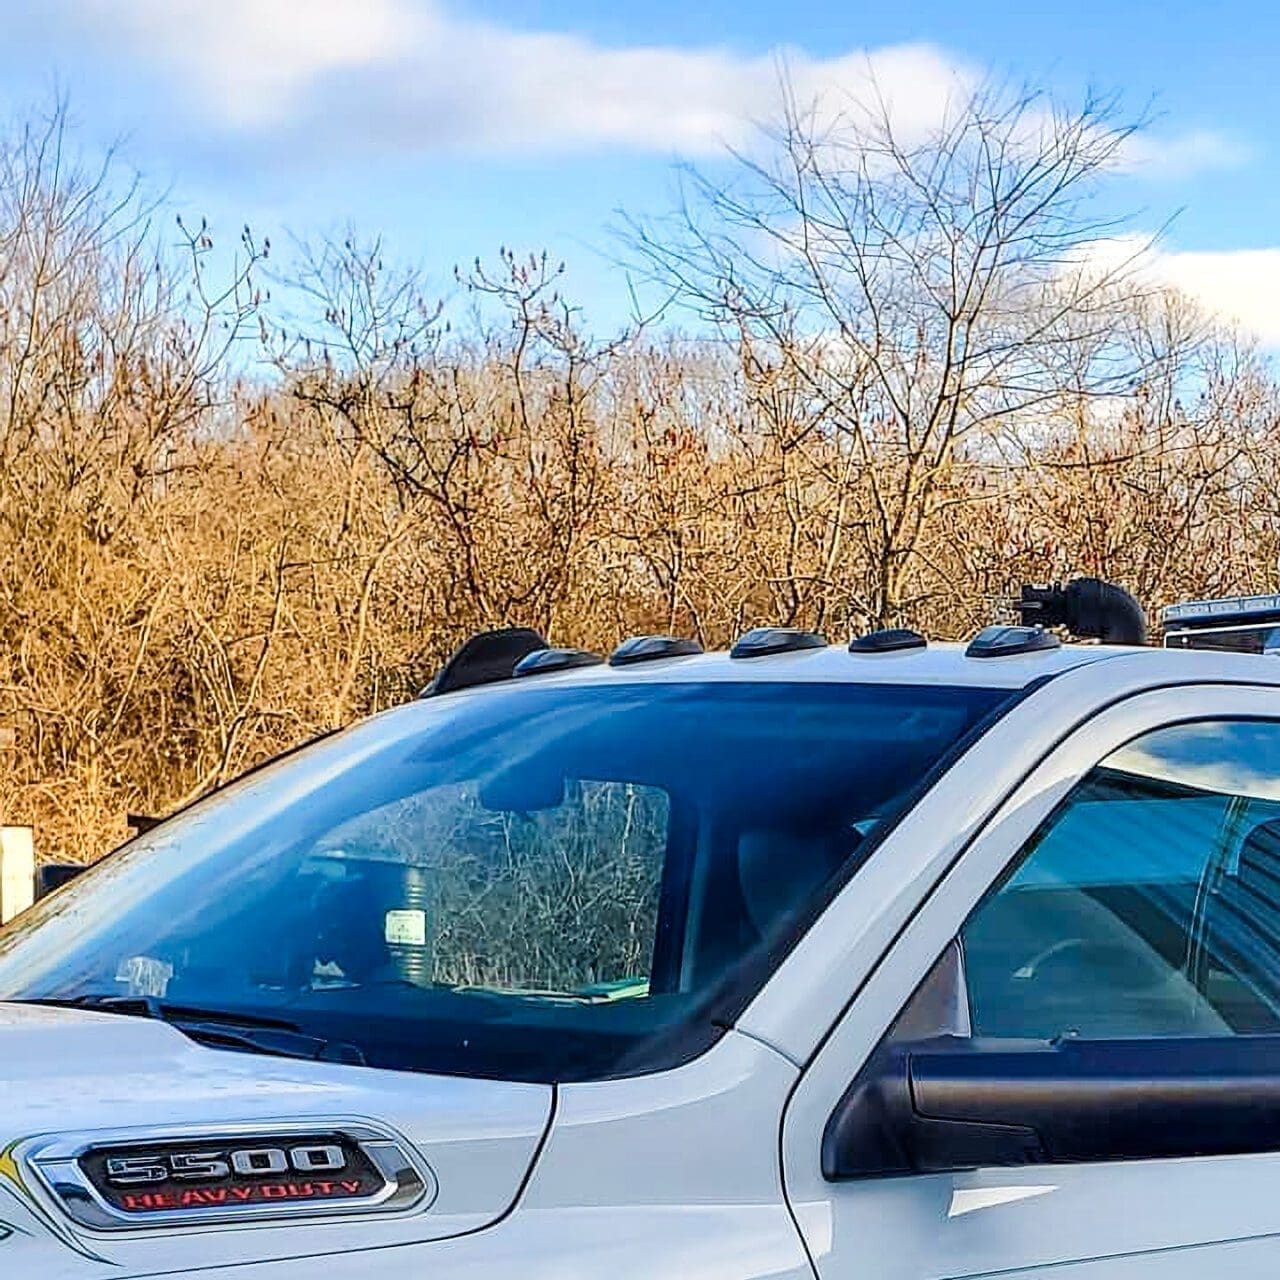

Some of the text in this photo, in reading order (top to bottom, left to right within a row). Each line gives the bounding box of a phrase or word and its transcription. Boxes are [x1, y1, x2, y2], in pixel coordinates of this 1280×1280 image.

[106, 1144, 346, 1183] 5500
[123, 1179, 361, 1210] HEAVY DUTY
